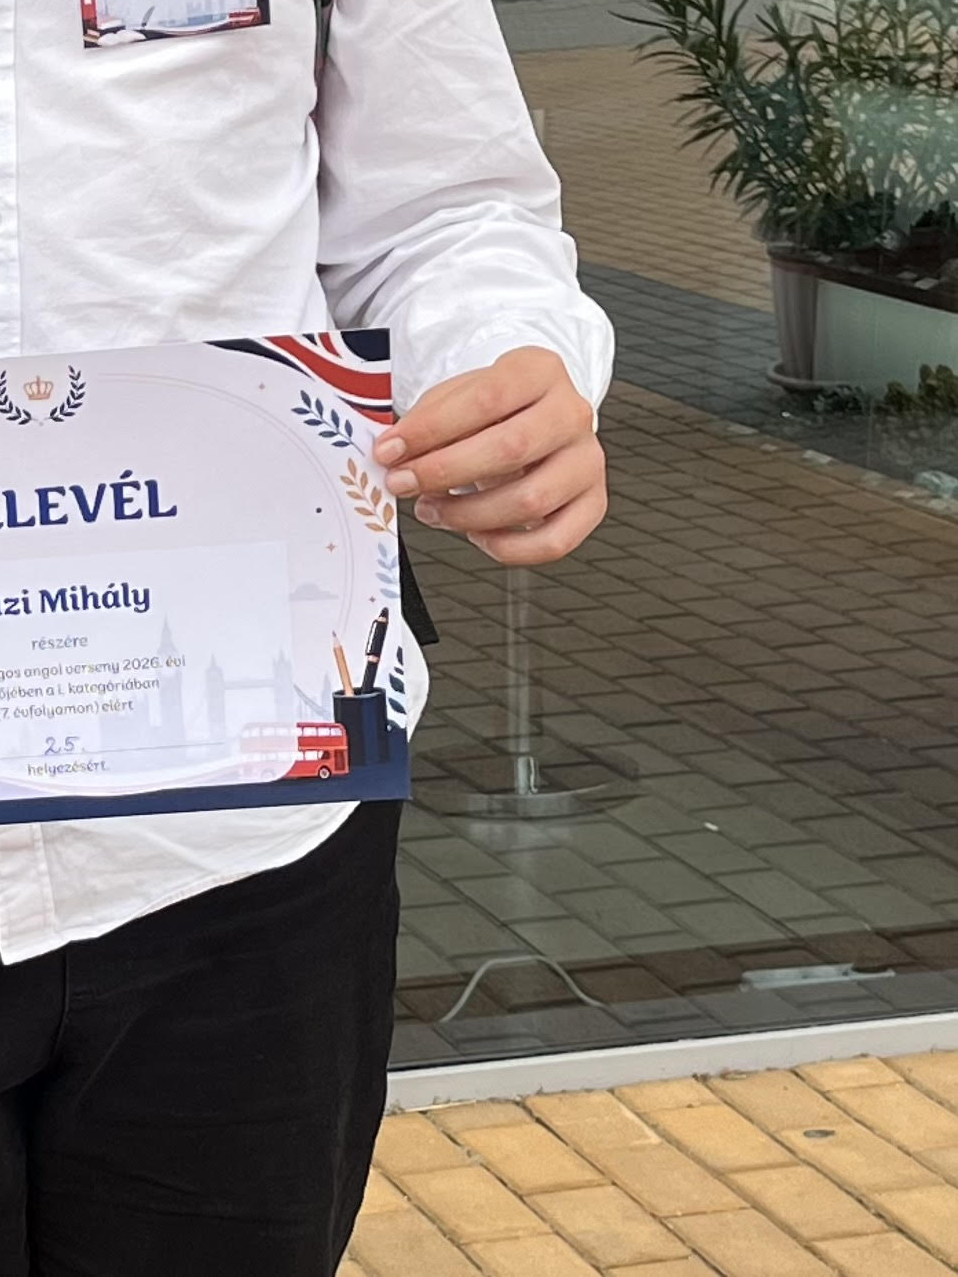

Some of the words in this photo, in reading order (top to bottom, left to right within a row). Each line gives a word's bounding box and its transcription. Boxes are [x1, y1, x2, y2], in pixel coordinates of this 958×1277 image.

[39, 582, 150, 614] Mihály
[31, 636, 89, 651] részére
[24, 663, 63, 680] angol
[65, 661, 120, 676] verseny
[122, 656, 163, 671] 2026.
[165, 654, 186, 668] évi
[45, 686, 55, 697] a
[68, 678, 160, 696] kategóriában
[13, 701, 99, 719] évfolyamon)
[101, 699, 134, 713] elért
